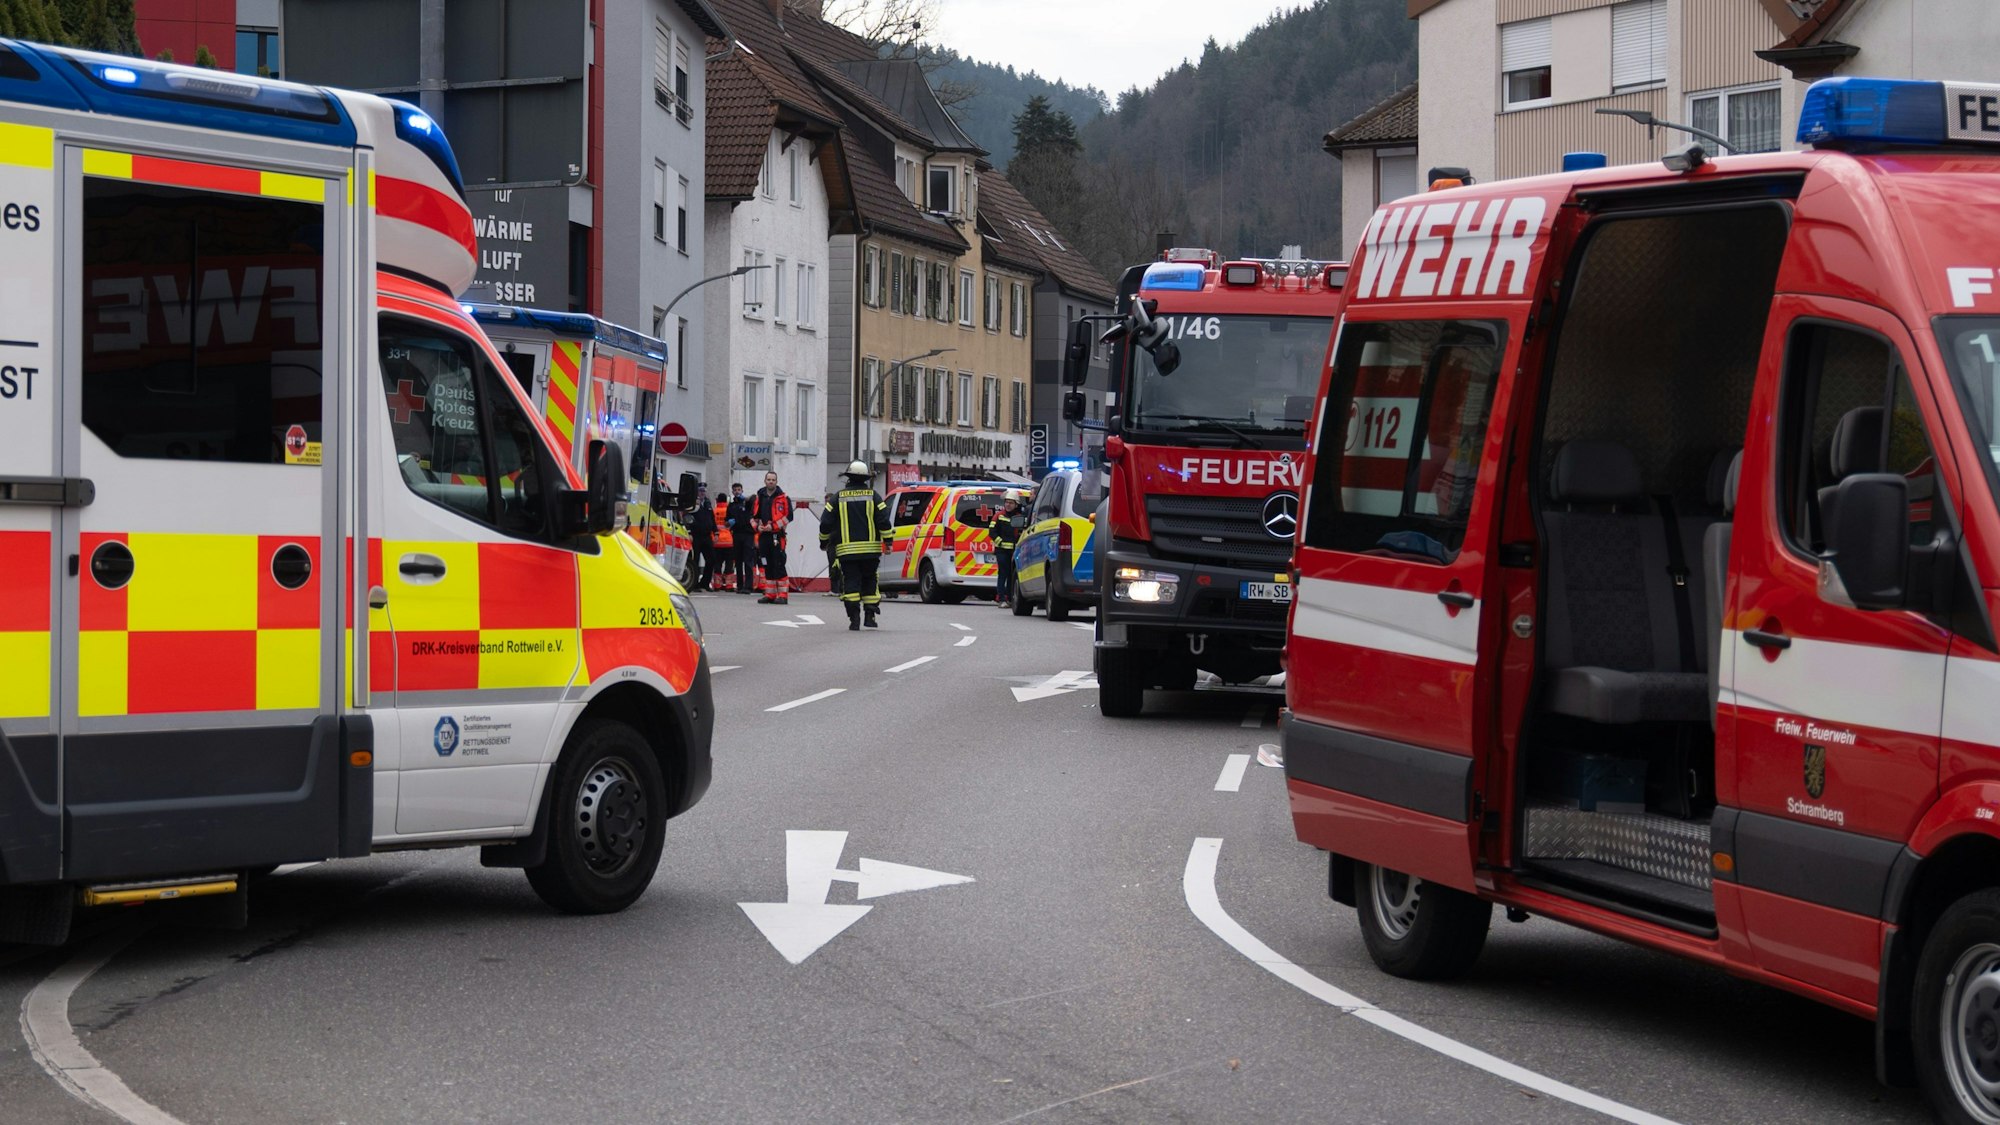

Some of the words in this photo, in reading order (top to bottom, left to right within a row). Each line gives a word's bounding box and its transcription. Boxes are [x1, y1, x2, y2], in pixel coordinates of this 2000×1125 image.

[0, 202, 40, 232] es
[473, 215, 533, 242] WÄRME
[1356, 197, 1546, 299] WEHR
[482, 250, 522, 271] LUFT
[471, 281, 535, 303] SSER
[1946, 267, 2000, 308] F
[433, 398, 475, 416] Rotes
[431, 414, 475, 431] Kreuz
[1363, 406, 1401, 449] 112
[1031, 429, 1046, 462] TOTO
[1249, 584, 1265, 598] RW
[1273, 584, 1289, 598] SB
[639, 607, 674, 626] 2/83-1
[412, 641, 504, 656] DRK-Kreisverband
[506, 640, 545, 653] Rottweil
[547, 640, 564, 652] e.V.
[463, 737, 511, 746] RETTUNGSDIENST
[1775, 717, 1803, 738] Freiw.
[1806, 723, 1857, 745] Feuerwehr
[462, 748, 489, 756] ROTTWEIL
[1787, 797, 1844, 826] Schramberg
